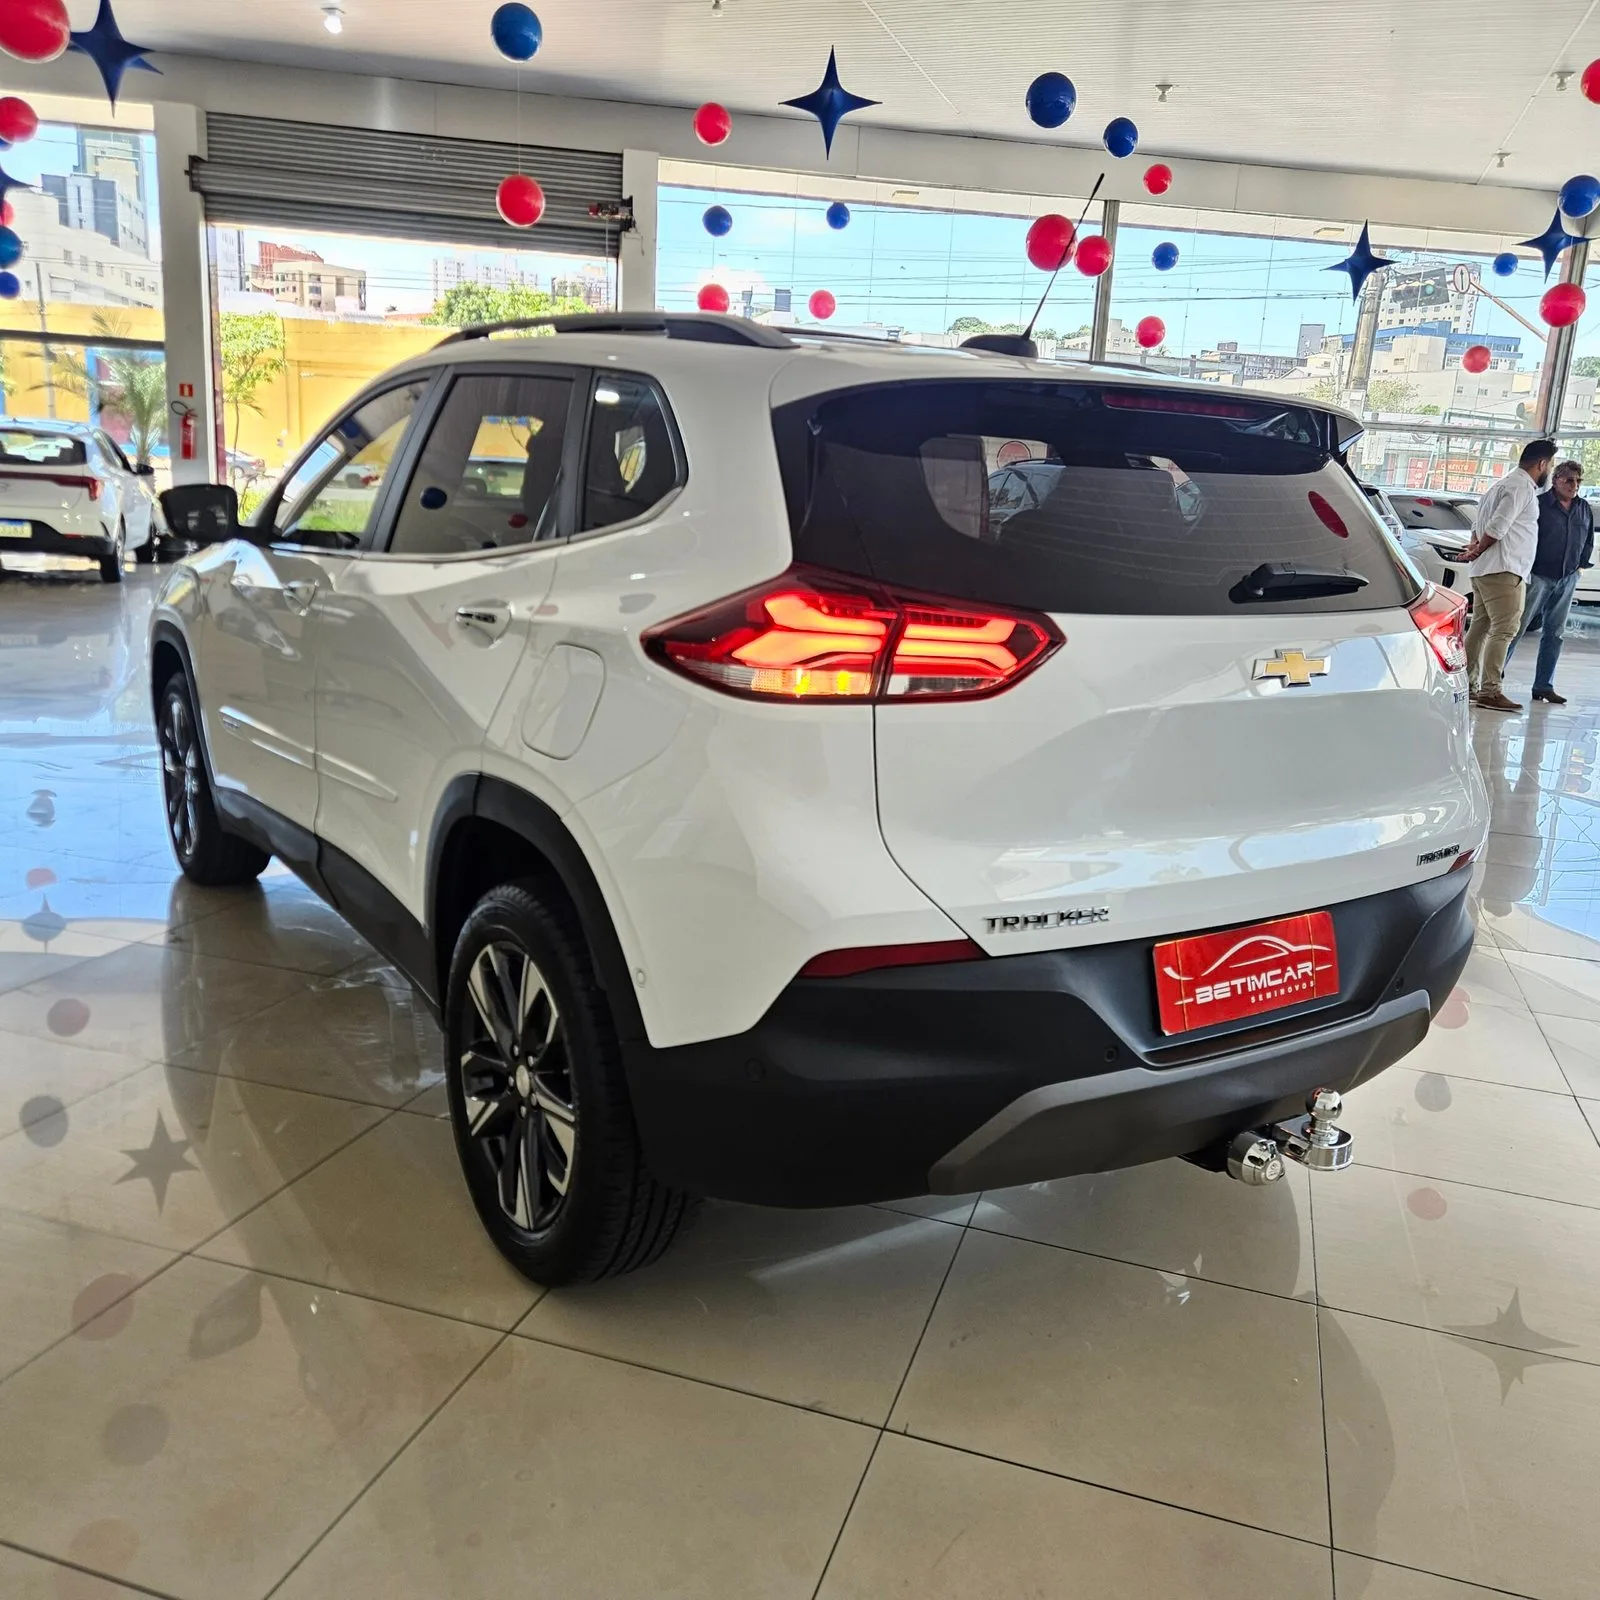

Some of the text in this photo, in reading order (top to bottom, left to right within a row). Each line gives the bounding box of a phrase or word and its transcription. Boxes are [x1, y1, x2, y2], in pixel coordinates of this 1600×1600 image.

[1441, 463, 1469, 471] CMENTO
[984, 906, 1110, 934] TRACKER
[1195, 961, 1313, 1005] BETIMCAR
[1250, 981, 1315, 1005] SEMINOVOS
